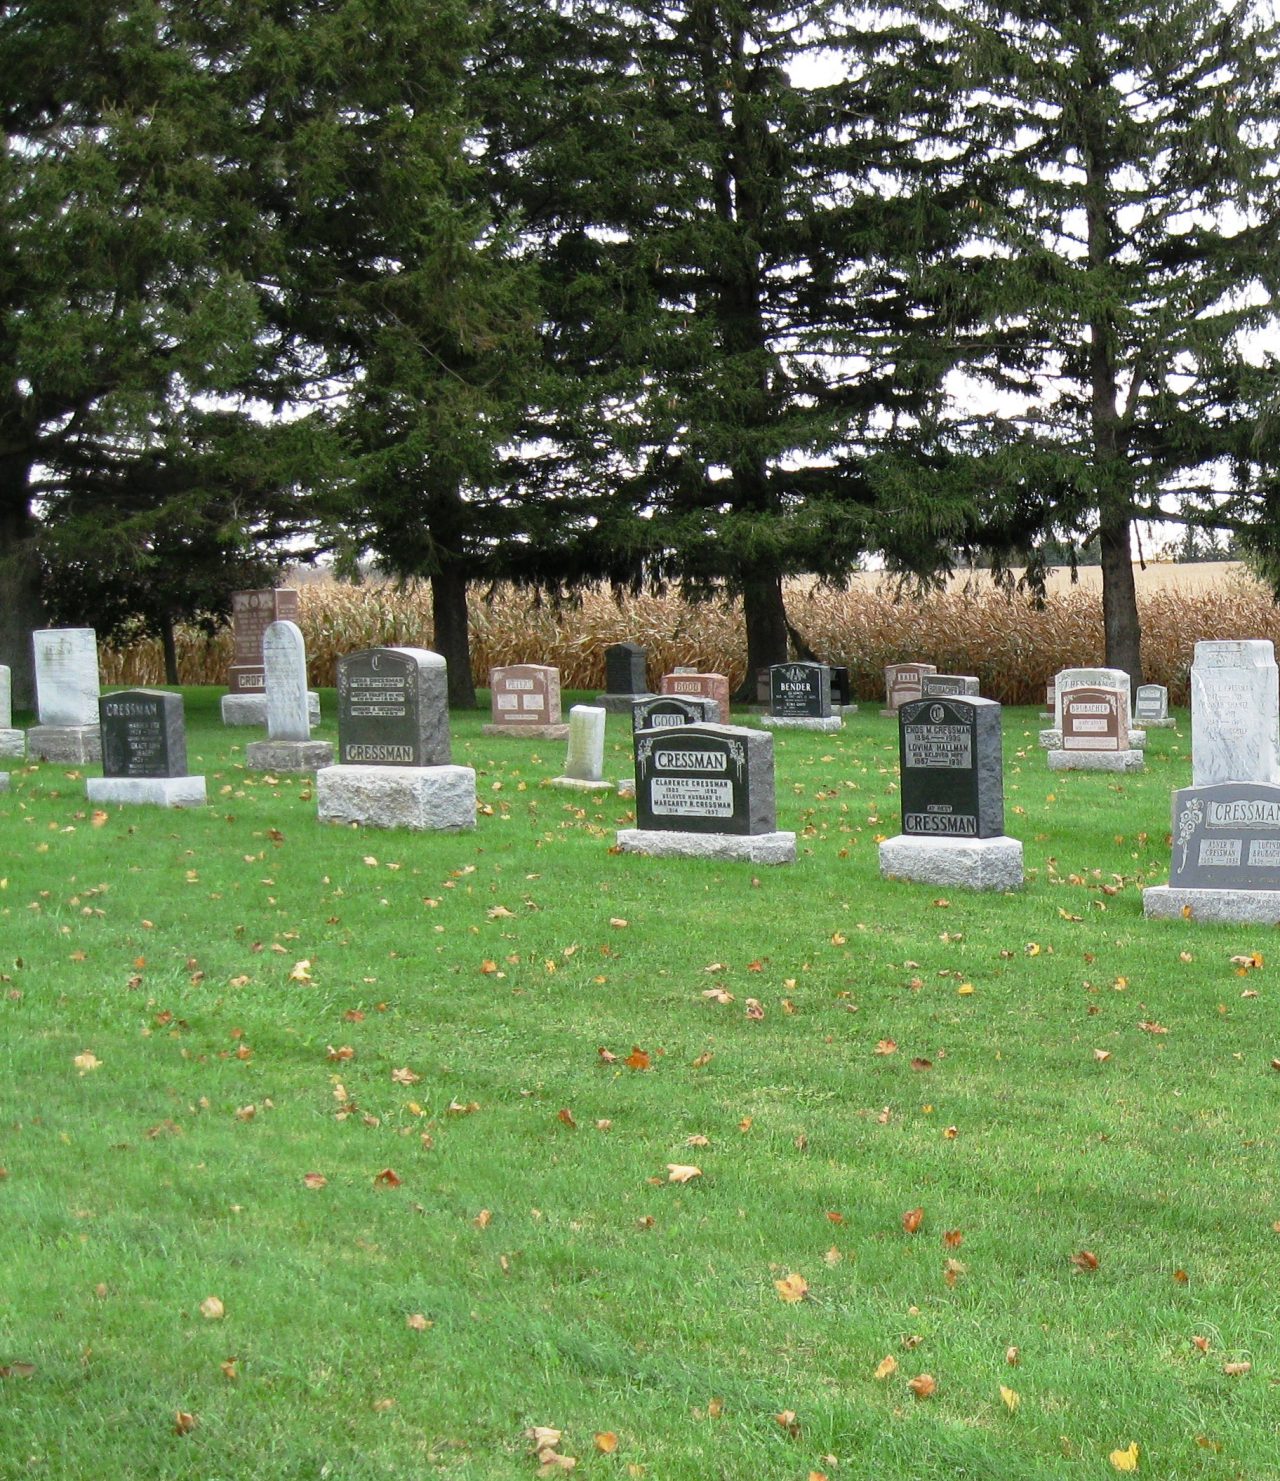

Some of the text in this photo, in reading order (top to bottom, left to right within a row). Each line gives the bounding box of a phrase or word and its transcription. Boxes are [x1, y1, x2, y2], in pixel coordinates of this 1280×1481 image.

[676, 682, 699, 691] GOOD
[780, 682, 812, 691] BENDER
[106, 703, 157, 717] CRESSMAN
[1071, 704, 1109, 713] BRUBACHER
[654, 715, 682, 727] GOOD
[908, 743, 969, 752] LOVINA HALLMAN
[349, 745, 411, 761] CRESSMAN
[658, 752, 723, 769] CRESSMAN
[691, 780, 728, 788] CRESSMAN
[907, 815, 975, 833] CRESSMAN
[1205, 849, 1236, 857] CRESSMAN
